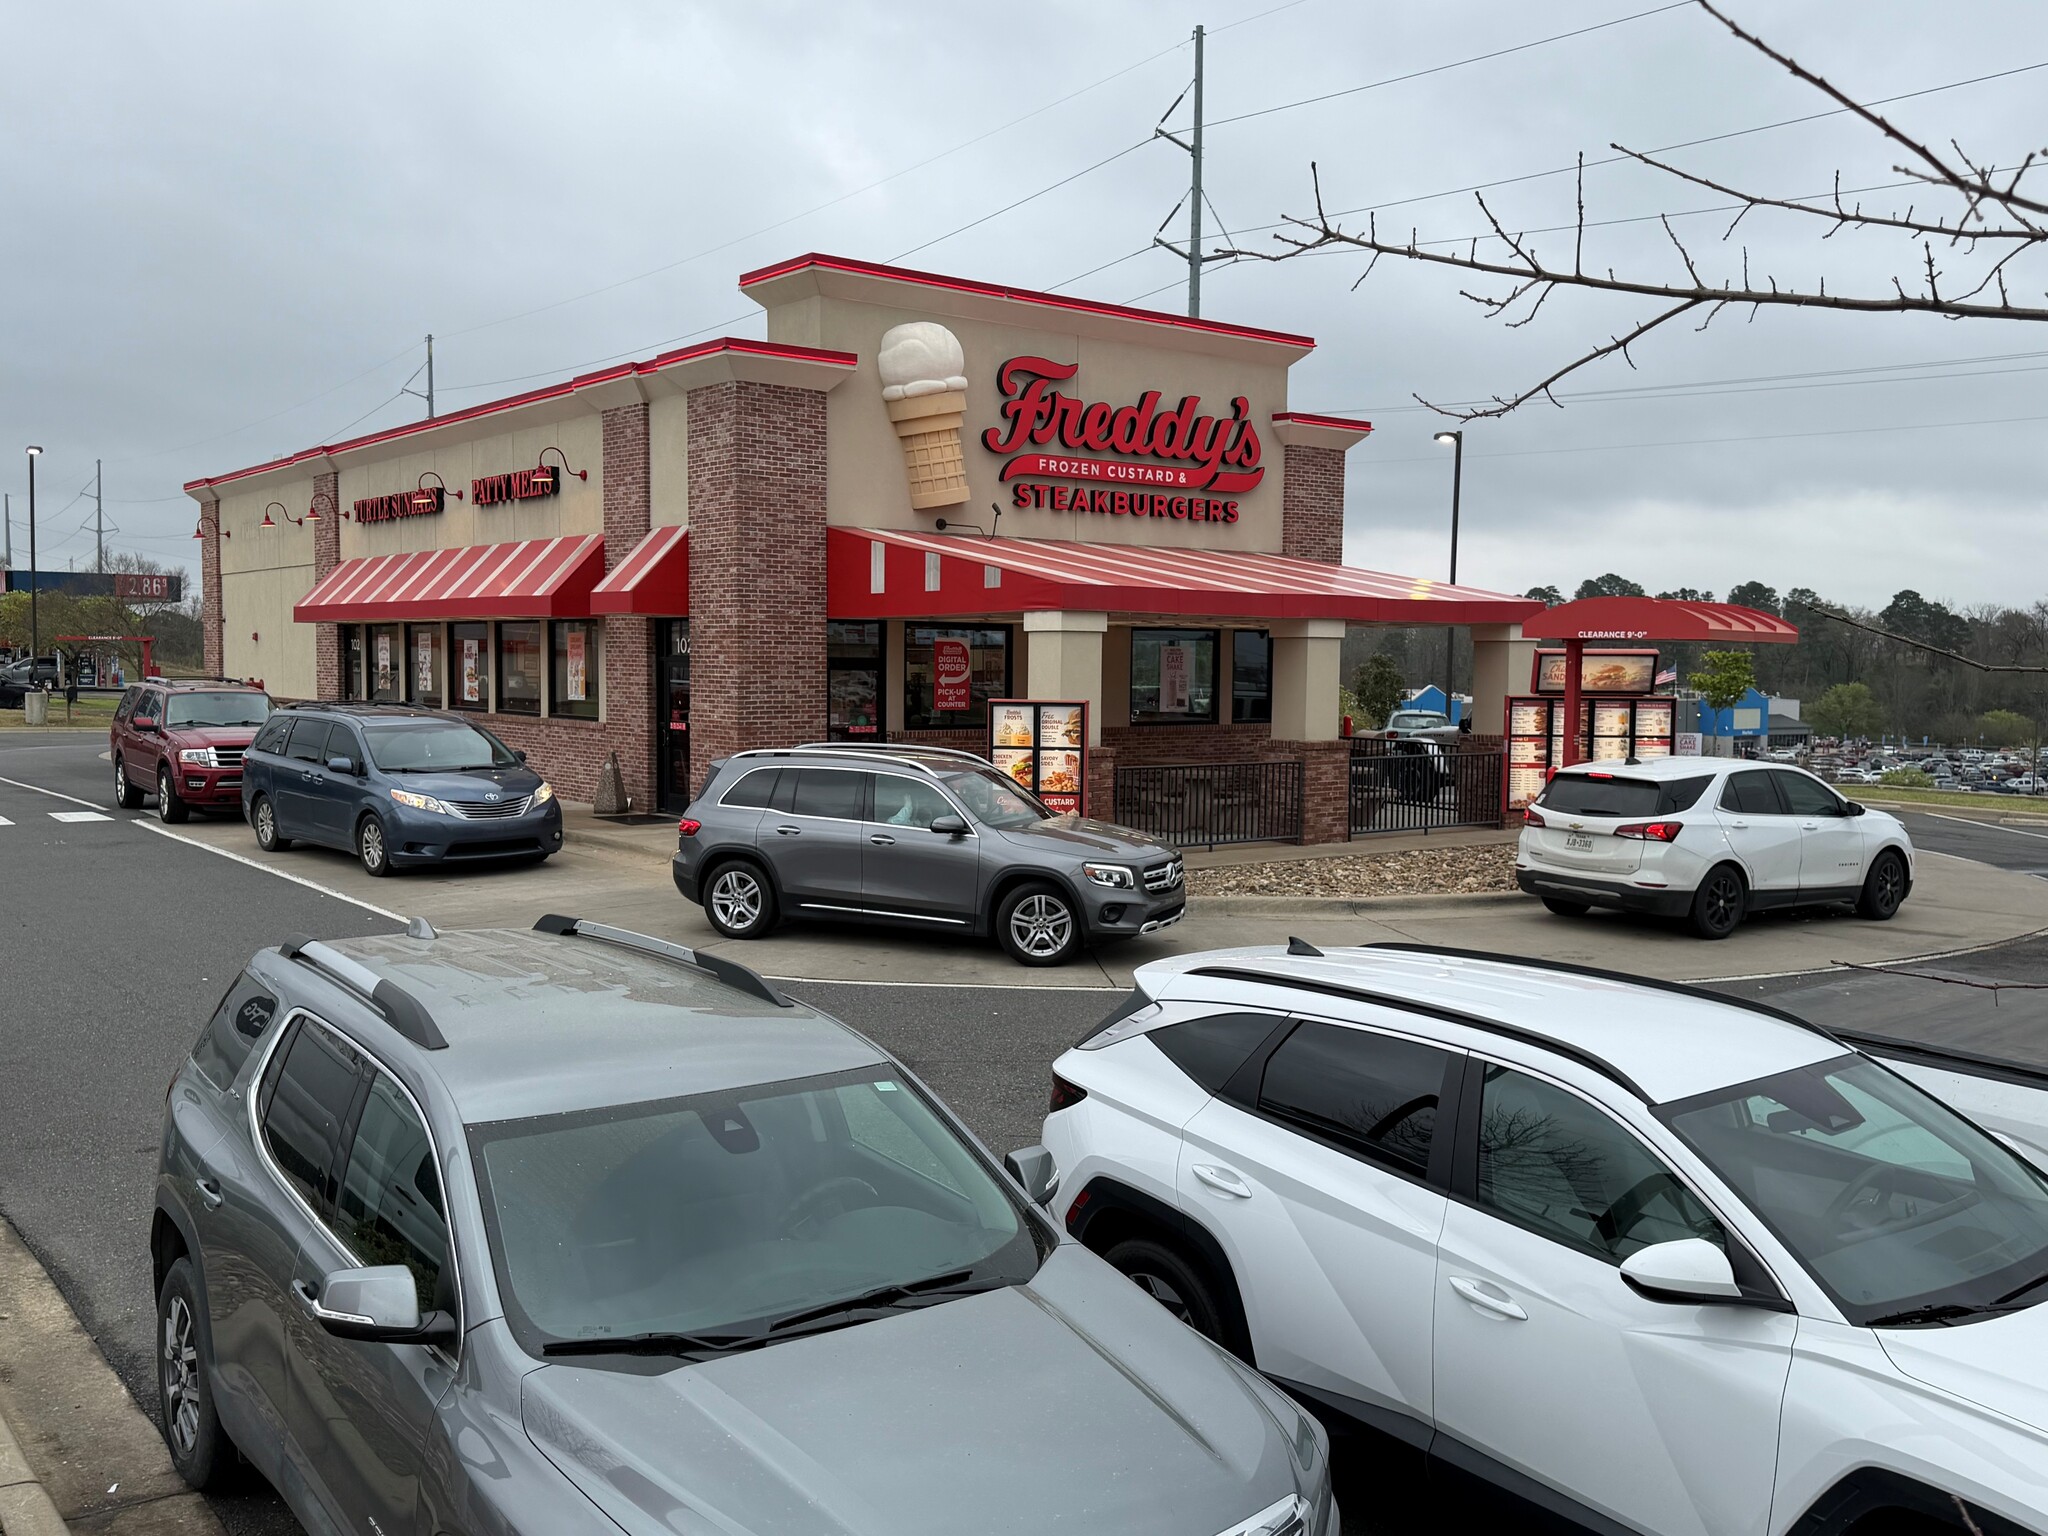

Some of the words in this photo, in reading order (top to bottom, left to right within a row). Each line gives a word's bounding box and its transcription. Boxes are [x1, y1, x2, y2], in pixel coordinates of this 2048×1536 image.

[981, 355, 1263, 474] Freddy's
[1039, 458, 1100, 476] FROZEN
[1107, 466, 1174, 483] CUSTARD
[1178, 472, 1187, 483] &
[471, 474, 508, 505] PATTY
[1013, 482, 1239, 523] STEAKBURGERS
[353, 495, 390, 523] TURTLE
[1577, 630, 1625, 639] CLEARANCE
[938, 656, 967, 664] DIGITAL
[1166, 655, 1184, 664] CAKE
[938, 664, 967, 672] ORDER
[937, 688, 966, 696] PICK-UP
[1041, 711, 1054, 719] Free
